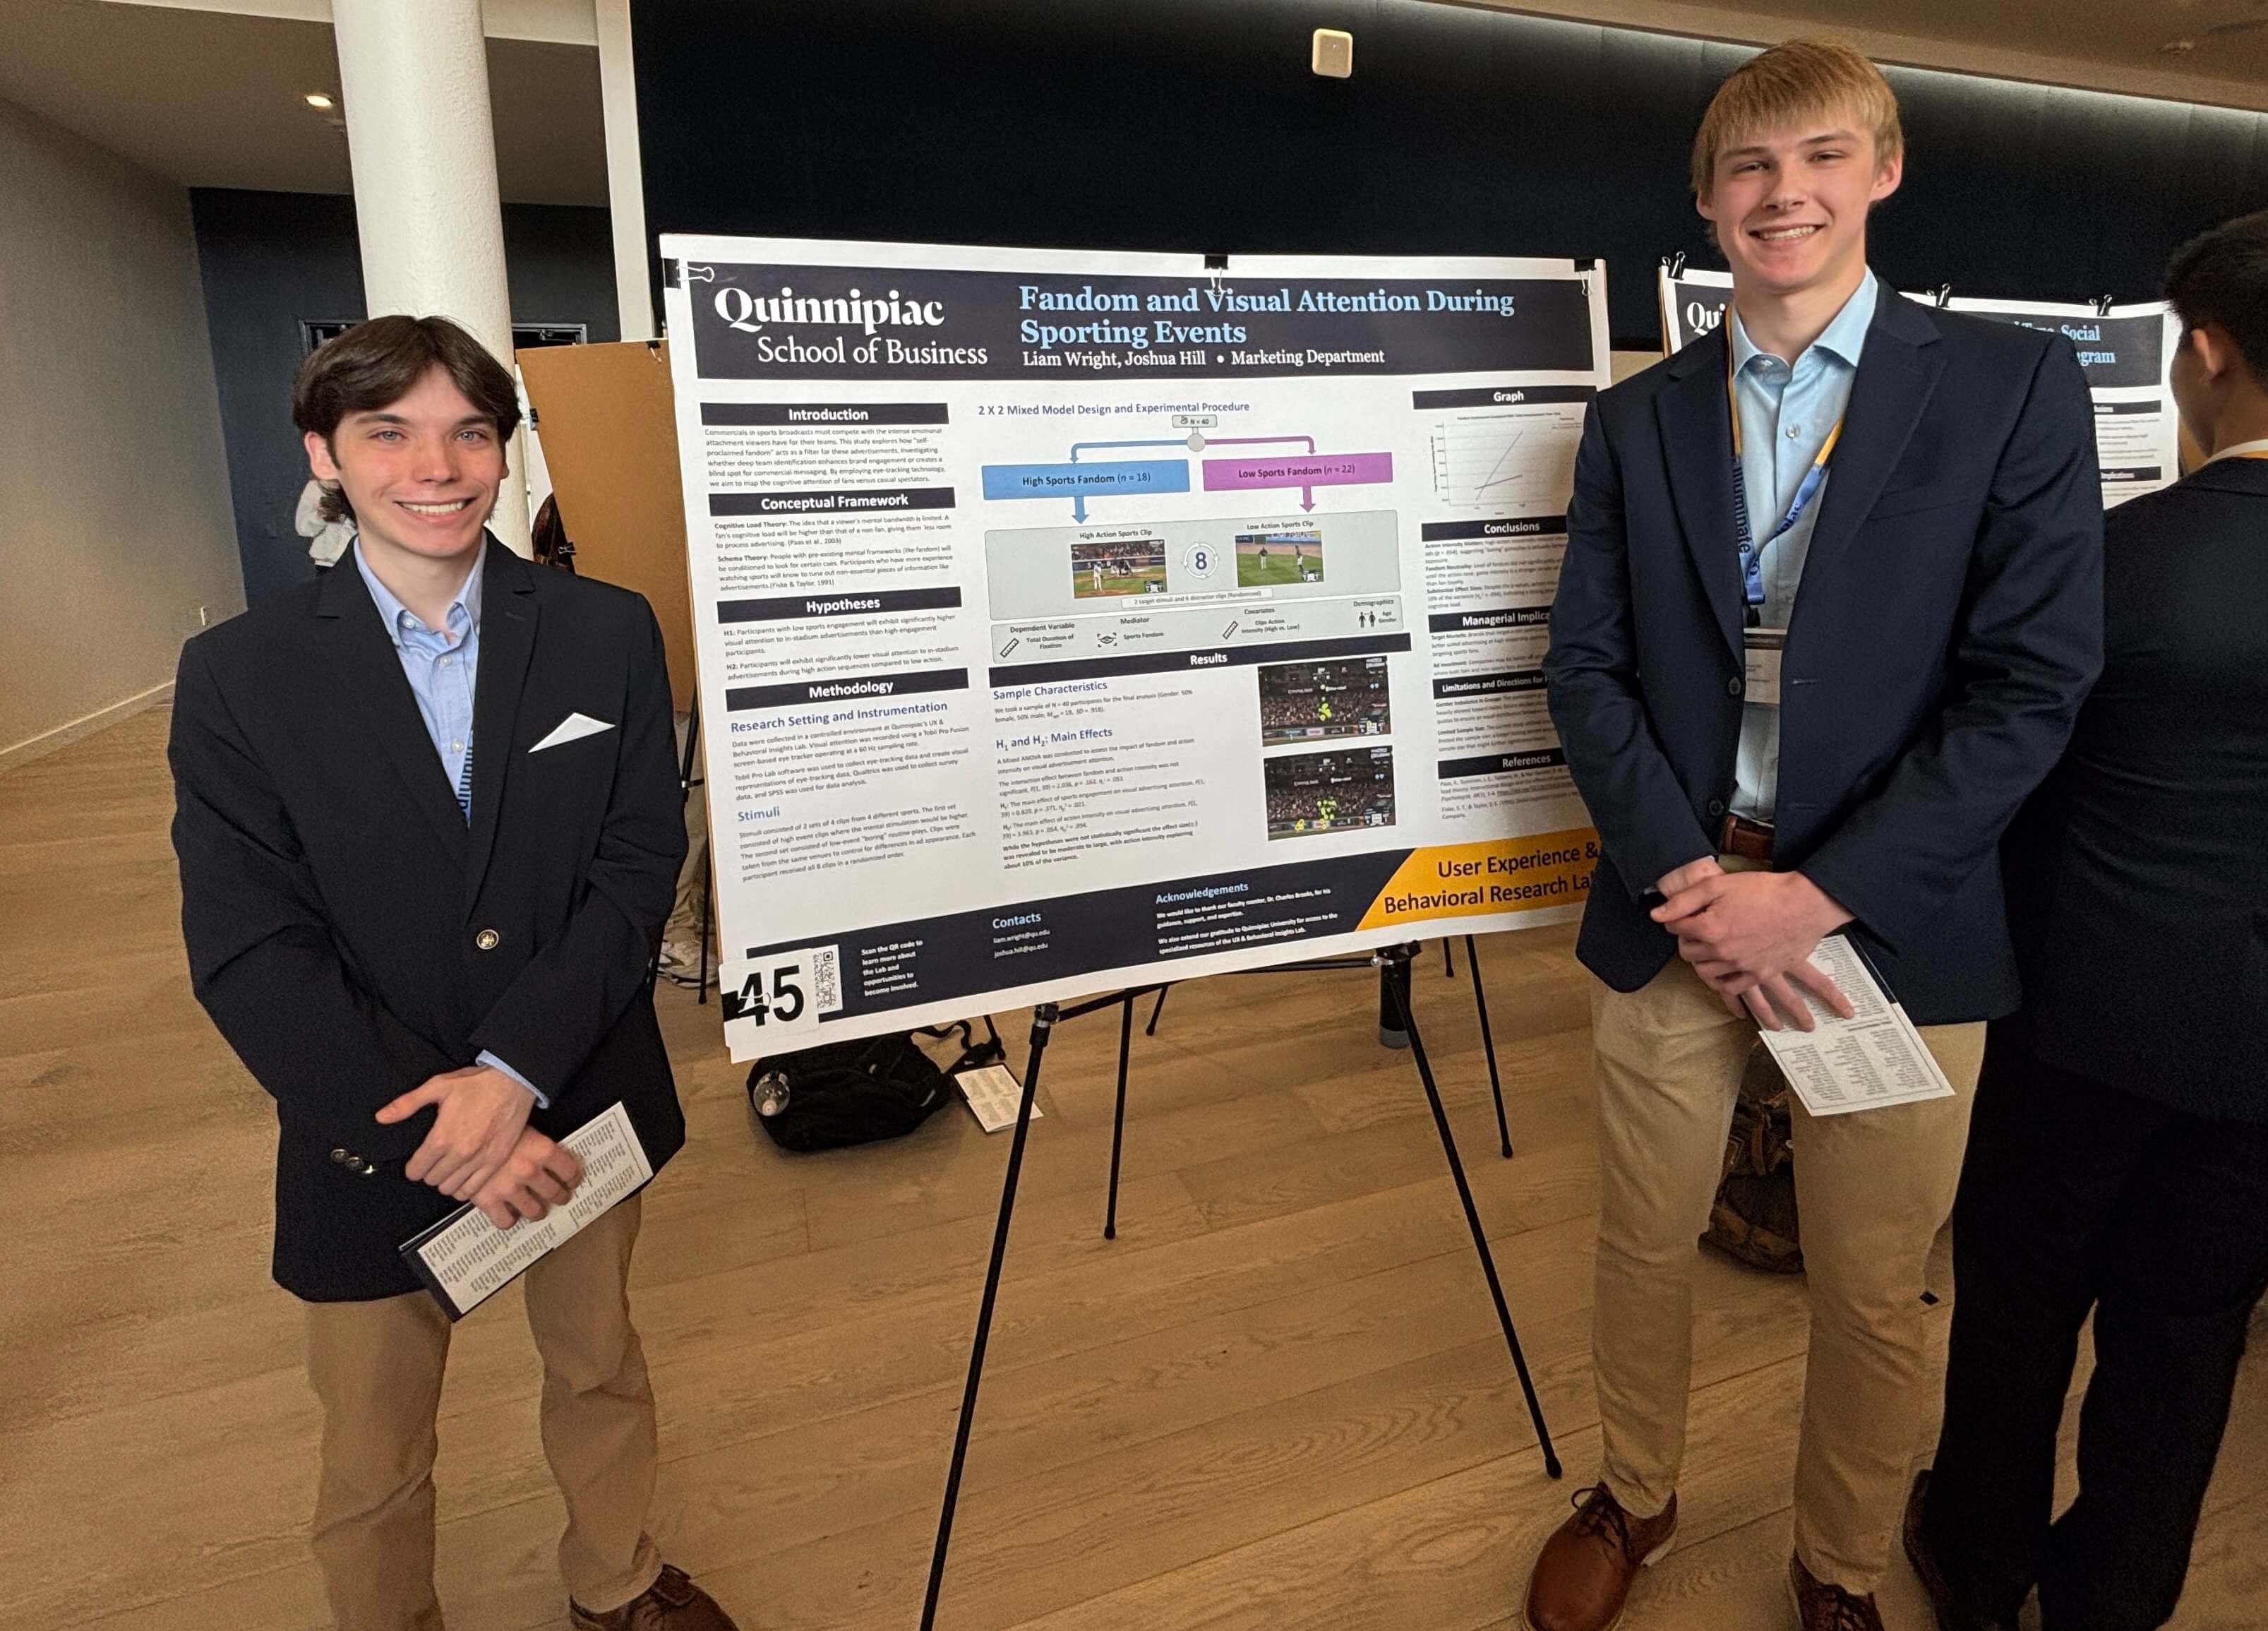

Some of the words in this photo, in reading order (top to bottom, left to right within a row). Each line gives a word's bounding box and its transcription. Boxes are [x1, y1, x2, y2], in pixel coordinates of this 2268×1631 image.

[1019, 285, 1138, 311] Fandom
[1147, 287, 1198, 311] and
[1204, 285, 1290, 311] Visual
[1297, 289, 1420, 311] Attention
[1427, 289, 1514, 316] During
[714, 287, 945, 335] Quinnipiac
[1021, 318, 1148, 349] Sporting
[1154, 321, 1246, 342] Events
[757, 336, 844, 363] School
[853, 337, 880, 363] of
[887, 339, 988, 364] Business
[1021, 347, 1062, 366] Liam
[1063, 350, 1122, 369] Wright,
[1124, 347, 1177, 366] Joshua
[1178, 350, 1206, 365] Hill
[1230, 349, 1304, 366] Marketing
[1305, 349, 1385, 366] Department
[2077, 351, 2116, 367] gram
[1493, 390, 1524, 403] Graph
[788, 408, 869, 421] Introduction
[978, 405, 985, 415] 2
[987, 405, 995, 415] X
[997, 405, 1004, 415] 2
[1007, 405, 1039, 414] Mixed
[1041, 404, 1074, 414] Model
[1077, 405, 1112, 416] Design
[1114, 402, 1133, 413] and
[1135, 402, 1199, 415] Experimental
[1201, 402, 1249, 412] Procedure
[1021, 476, 1044, 487] High
[1045, 476, 1076, 486] Sports
[1076, 474, 1115, 484] Fandom
[1117, 472, 1127, 484] (n
[1136, 471, 1151, 482] 18)
[1237, 470, 1256, 478] Low
[1256, 468, 1285, 479] Sports
[1286, 466, 1322, 476] Fandom
[1324, 465, 1333, 476] (n
[1340, 463, 1355, 474] 22)
[761, 496, 834, 510] Conceptual
[837, 494, 908, 510] Framework
[1484, 522, 1540, 534] Conclusions
[1195, 551, 1207, 570] 8
[806, 598, 882, 613] Hypotheses
[1353, 599, 1394, 607] Demographics
[1120, 616, 1150, 625] Mediator
[1462, 611, 1516, 627] Managerial
[1009, 624, 1046, 633] Dependent
[1189, 652, 1228, 666] Results
[808, 680, 894, 698] Methodology
[993, 688, 1031, 700] Sample
[1033, 681, 1108, 695] Characteristics
[1442, 681, 1481, 693] Limitations
[1482, 679, 1495, 688] and
[1496, 676, 1532, 688] Directions
[730, 717, 786, 732] Research
[787, 714, 830, 726] Setting
[832, 710, 854, 722] and
[856, 703, 948, 718] Instrumentation
[1011, 736, 1031, 748] and
[1050, 732, 1077, 743] Main
[1079, 727, 1113, 740] Effects
[1502, 754, 1552, 768] References
[738, 806, 781, 822] Stimuli
[1438, 860, 1482, 878] User
[1487, 849, 1579, 873] Experience
[1586, 841, 1599, 859] &
[1156, 883, 1249, 904] Acknowledgements
[1384, 886, 1484, 913] Behavioral
[1489, 876, 1568, 902] Research
[992, 912, 1042, 929] Contacts
[738, 965, 805, 1027] 45
